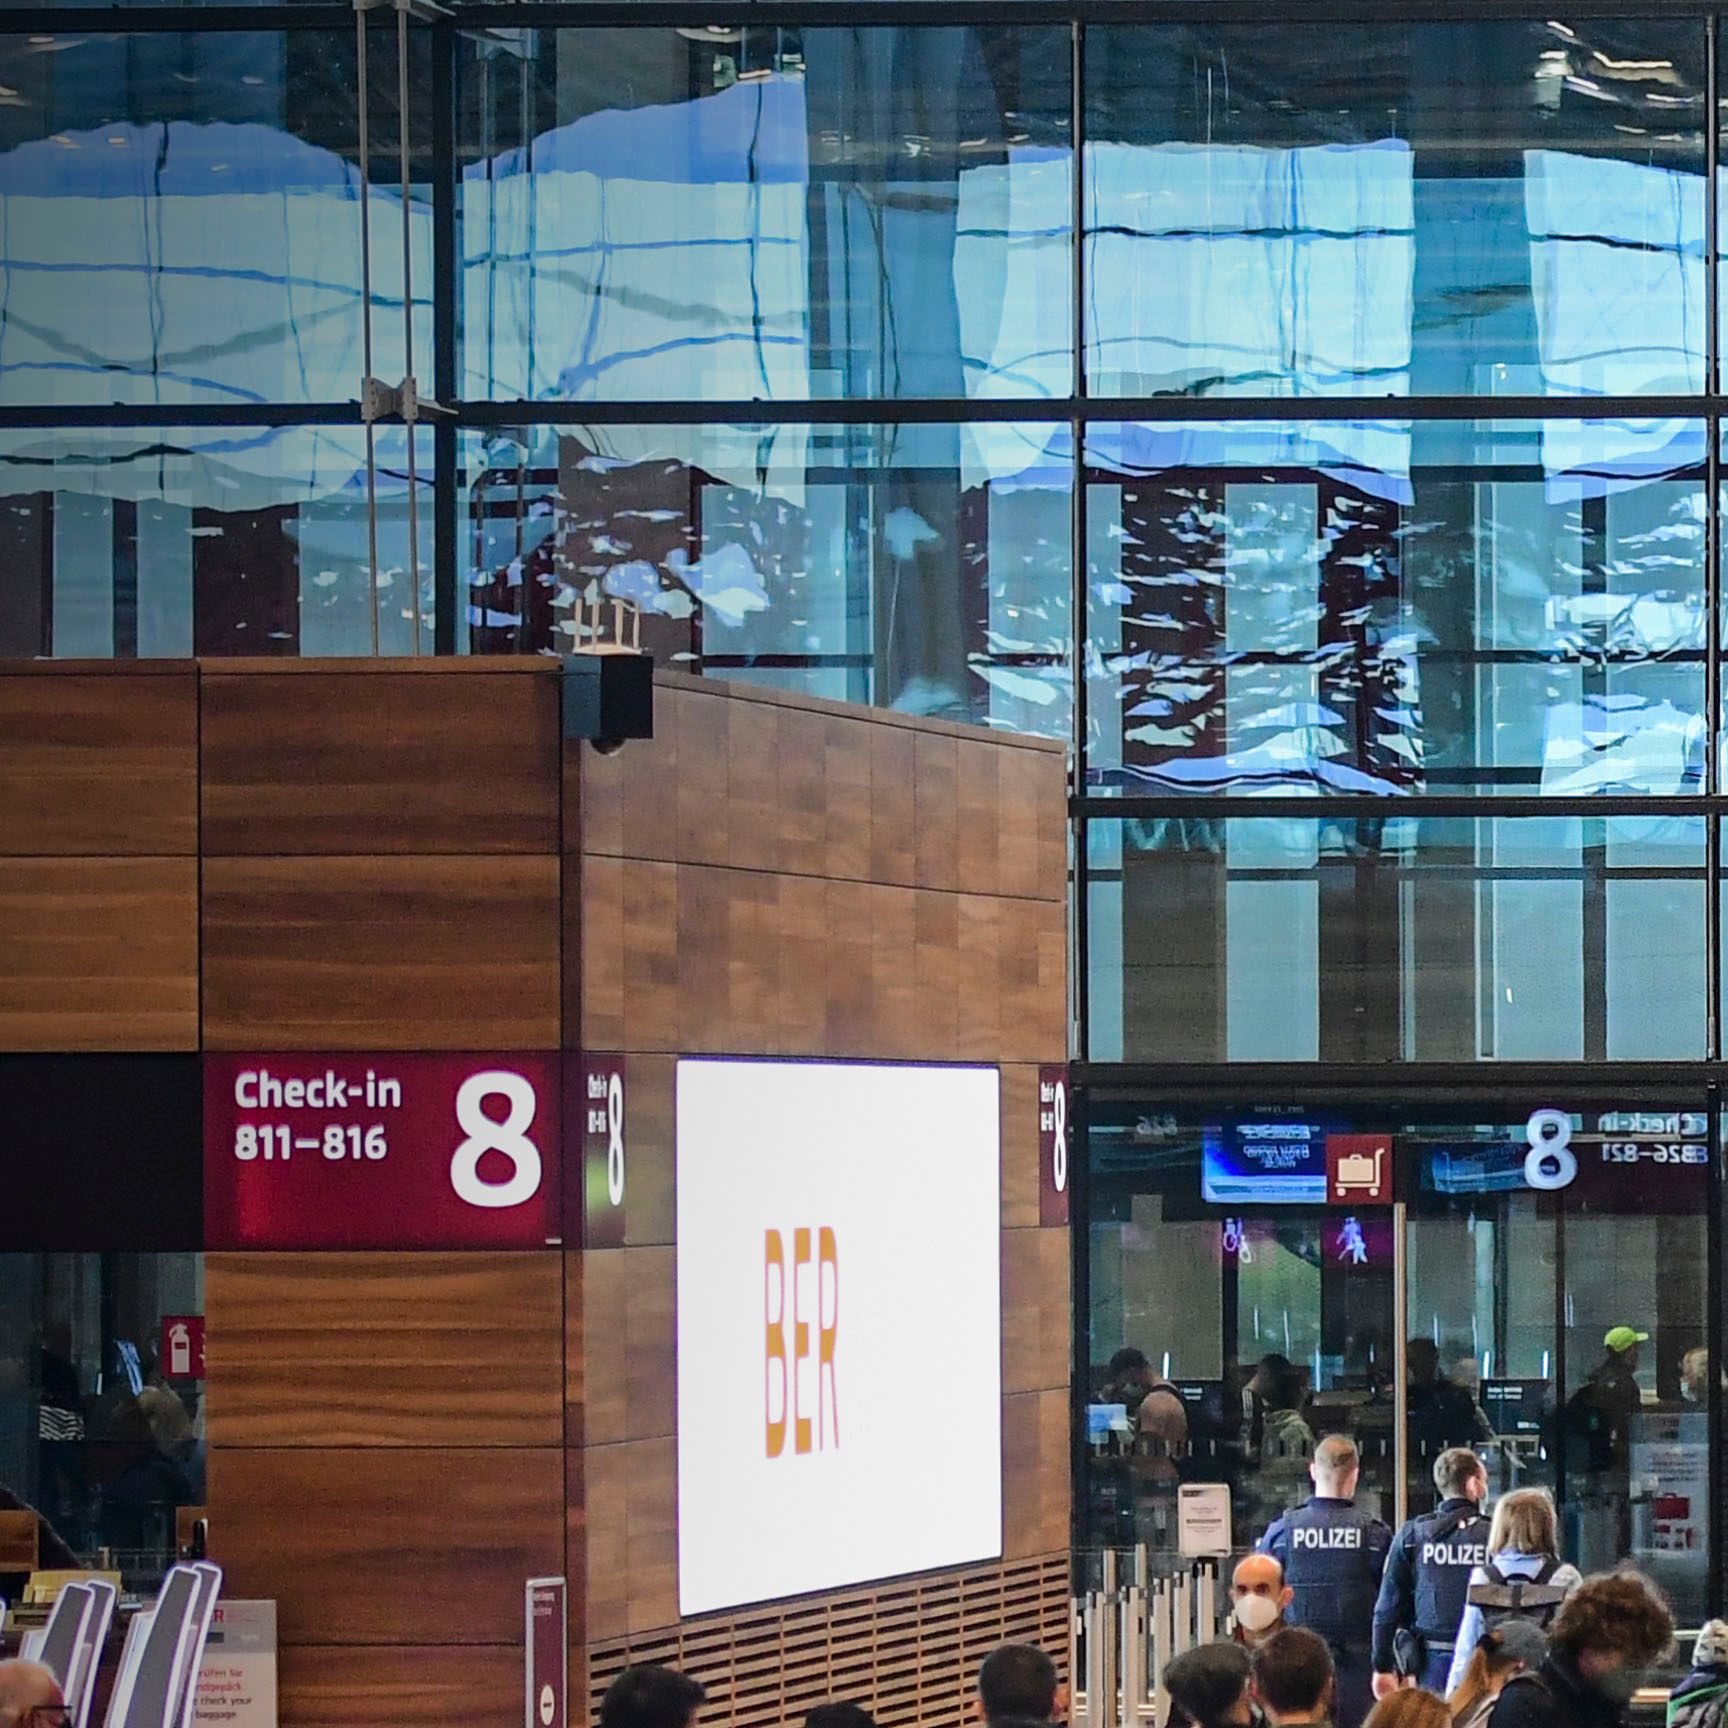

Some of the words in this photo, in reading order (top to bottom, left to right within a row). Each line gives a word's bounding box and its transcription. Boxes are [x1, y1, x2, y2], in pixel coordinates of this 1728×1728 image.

[234, 1070, 400, 1108] Check-in
[450, 1070, 542, 1208] 8
[608, 1073, 625, 1207] 8
[1053, 1081, 1067, 1192] 8
[765, 1225, 840, 1460] BER
[1292, 1527, 1362, 1550] POLIZEI
